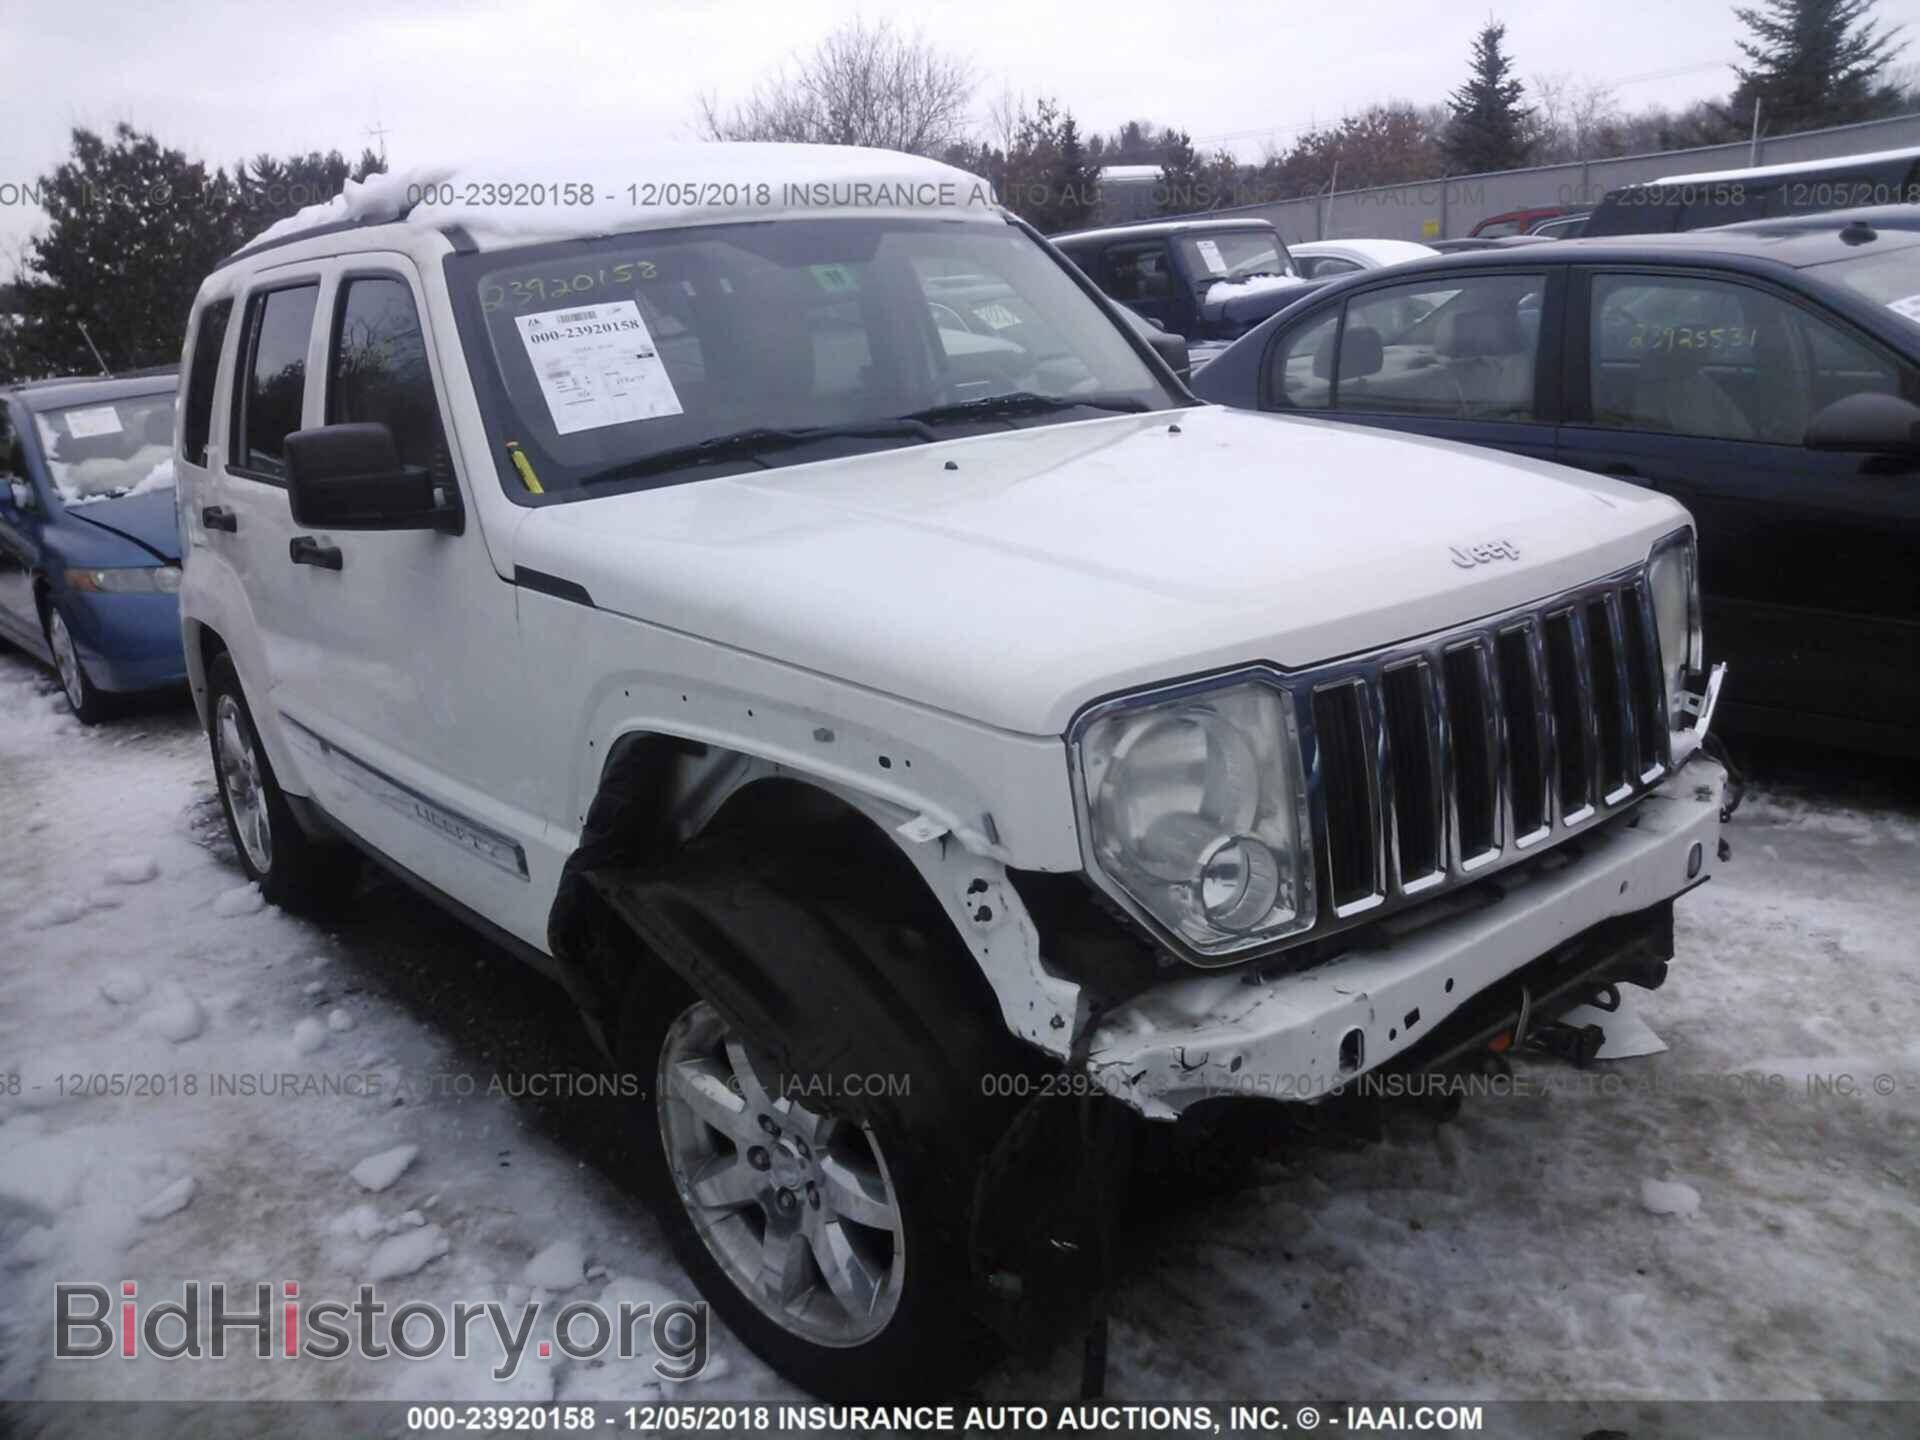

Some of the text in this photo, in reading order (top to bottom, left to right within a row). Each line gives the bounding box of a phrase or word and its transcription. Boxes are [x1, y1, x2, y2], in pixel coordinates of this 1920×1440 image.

[482, 260, 658, 313] 23920158
[530, 318, 641, 346] 000-23920158
[1447, 538, 1521, 569] Jeep
